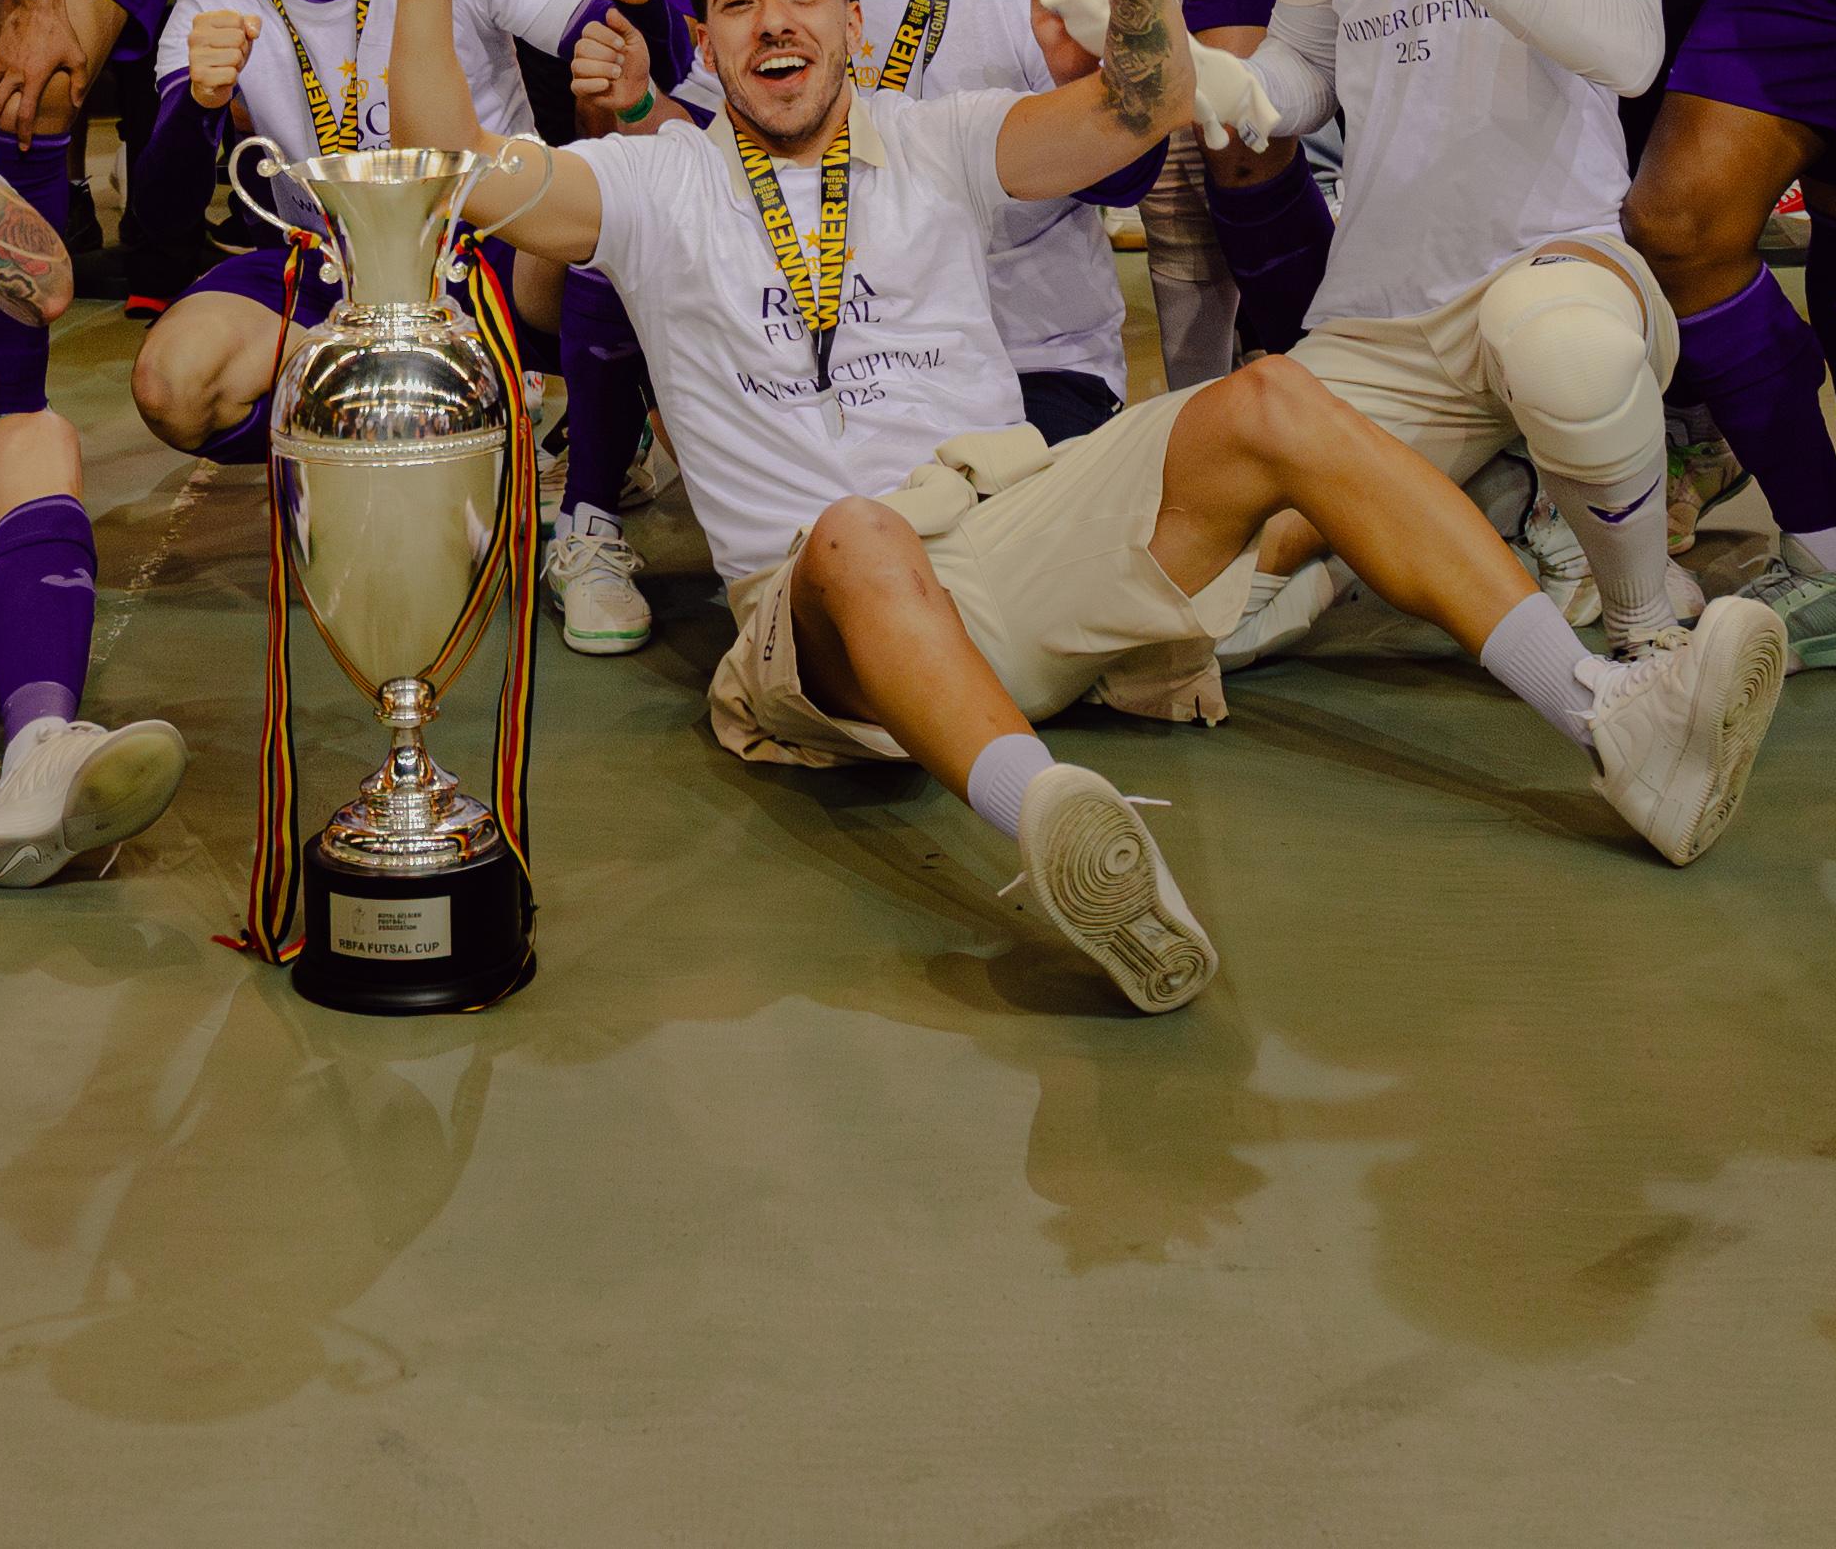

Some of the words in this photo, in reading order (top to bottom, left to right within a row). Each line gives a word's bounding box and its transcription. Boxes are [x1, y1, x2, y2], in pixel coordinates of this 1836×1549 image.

[761, 204, 821, 331] WINNER
[818, 200, 848, 331] WINNER
[762, 273, 878, 319] RA
[838, 384, 887, 408] 025
[338, 937, 365, 952] RBFA
[367, 942, 412, 954] FUTSAL
[414, 941, 440, 954] CUP
